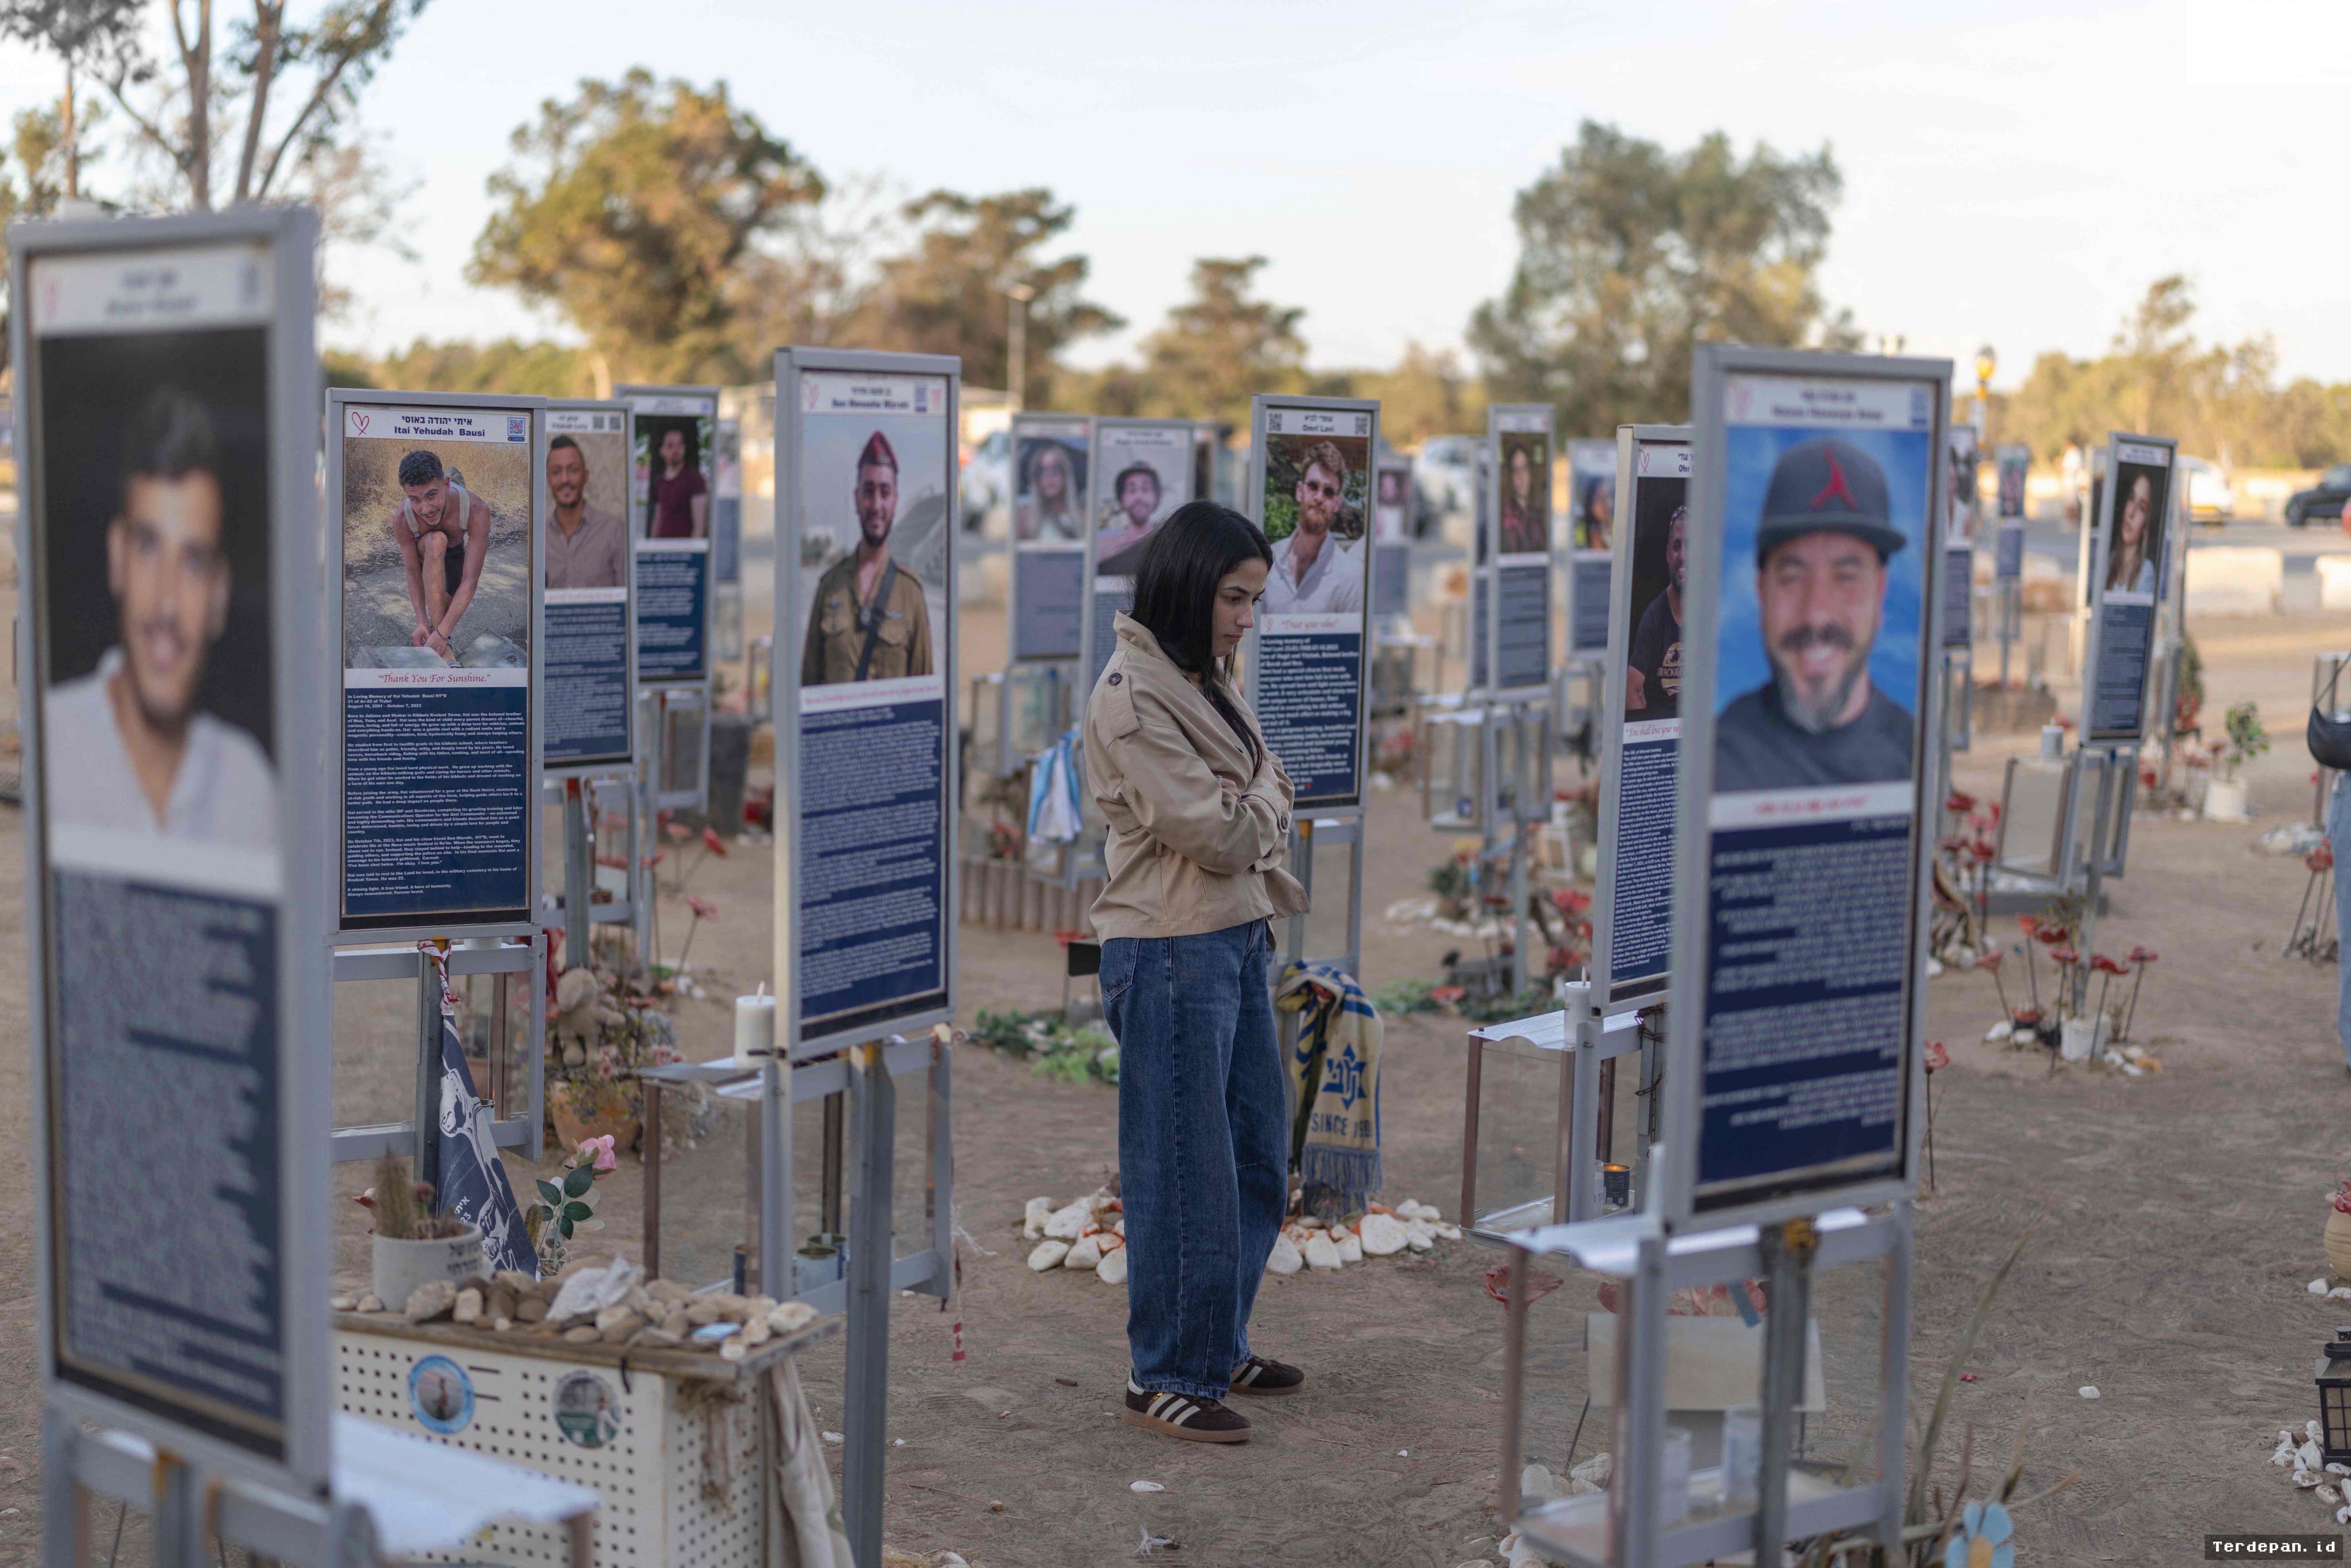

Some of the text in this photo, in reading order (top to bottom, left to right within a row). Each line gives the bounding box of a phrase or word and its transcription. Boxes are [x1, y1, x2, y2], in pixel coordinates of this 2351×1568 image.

[1660, 727, 1673, 738] your
[1673, 724, 1681, 736] neig
[1311, 1113, 1349, 1136] SINCE
